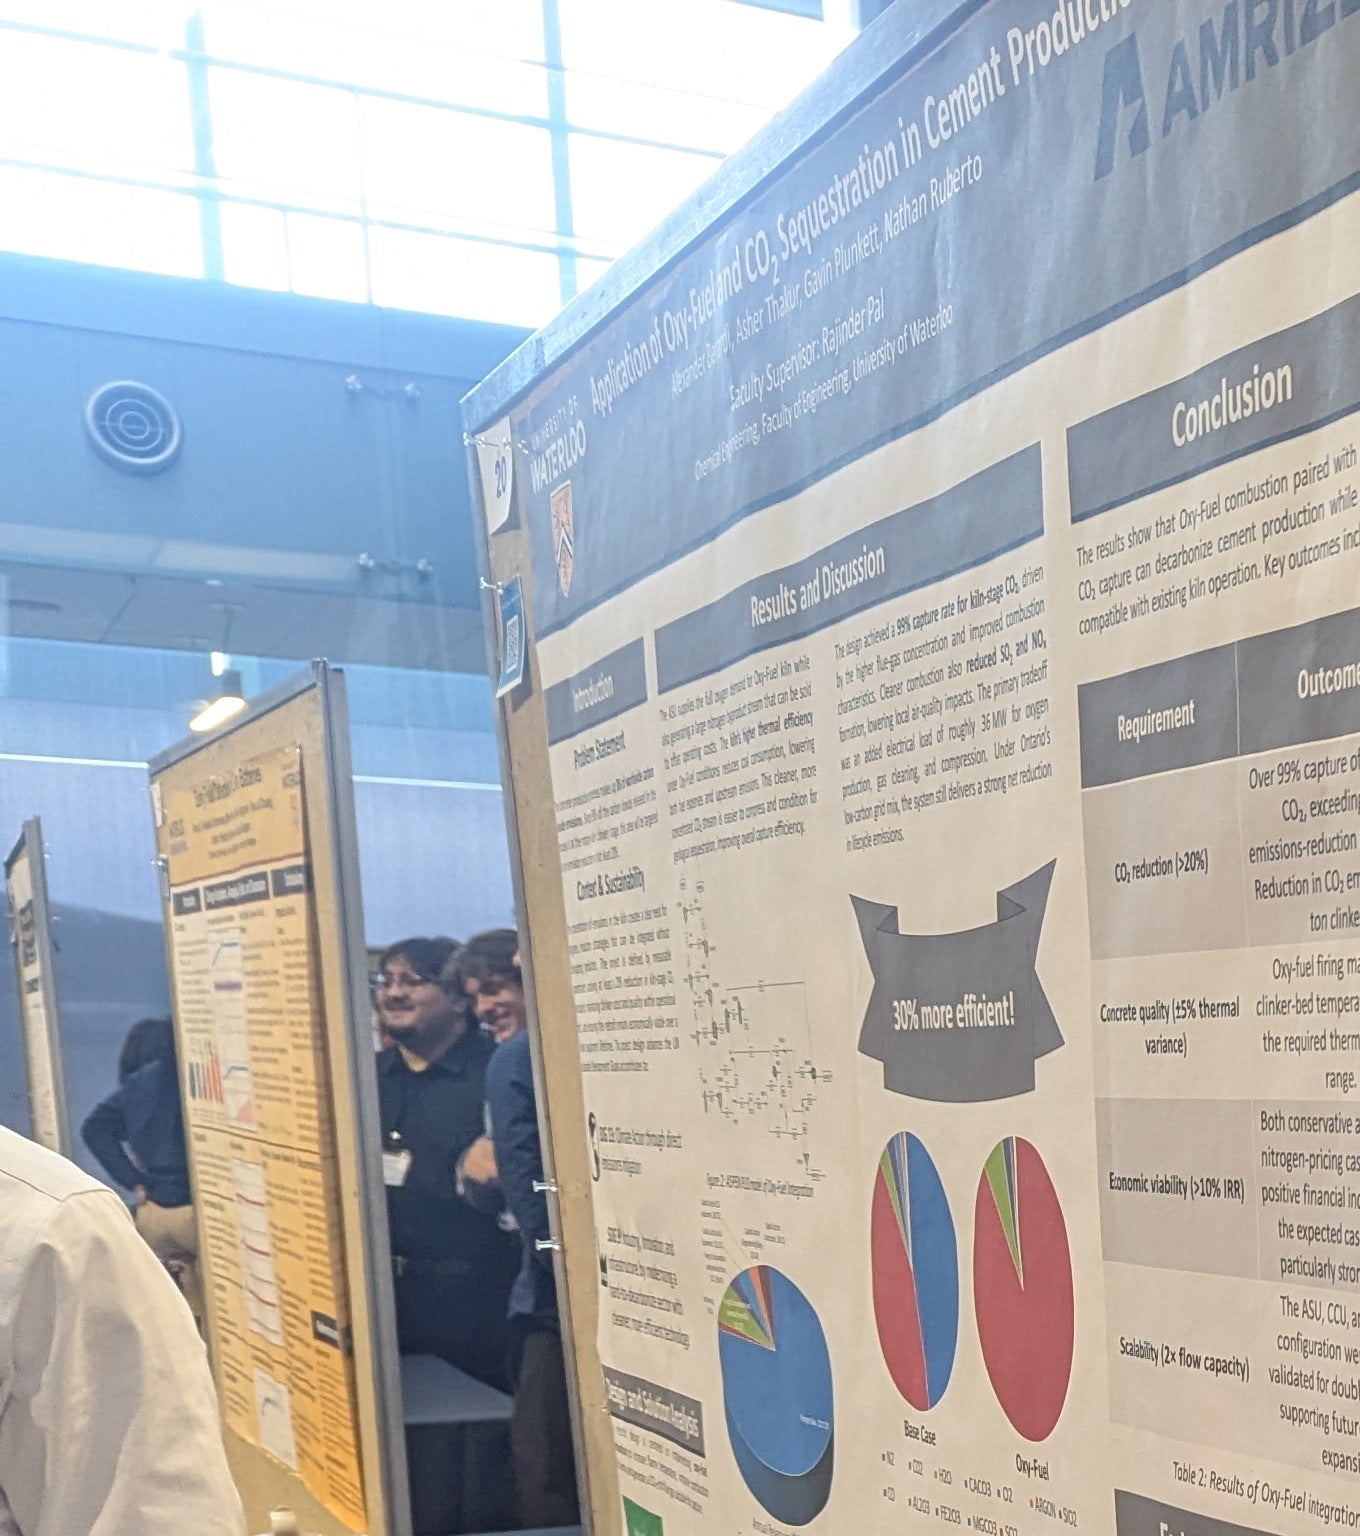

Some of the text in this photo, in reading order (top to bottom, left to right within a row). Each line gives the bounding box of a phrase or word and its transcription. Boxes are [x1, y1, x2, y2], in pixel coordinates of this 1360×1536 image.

[590, 346, 651, 419] Application
[651, 328, 664, 366] of
[663, 275, 715, 352] Oxy-Fuel
[716, 245, 742, 308] and
[776, 142, 901, 261] Sequestration
[899, 116, 921, 168] in
[923, 53, 1006, 150] Cement
[736, 310, 763, 344] Asher
[765, 283, 802, 319] Thakur,
[804, 257, 833, 299] Gavin
[834, 223, 883, 276] Plunkett,
[884, 193, 927, 239] Nathan
[929, 153, 983, 212] Ruberto
[730, 287, 884, 412] Faculty Supervisor: Rajinder Pal
[762, 400, 792, 436] Faculty
[793, 394, 801, 418] of
[802, 369, 851, 413] Engineering,
[853, 339, 896, 382] University
[898, 324, 908, 354] of
[909, 304, 953, 347] Waterloo
[1172, 364, 1293, 447] Conclusion
[494, 455, 507, 499] 20
[530, 419, 587, 494] WATERLOO
[1077, 547, 1093, 567] The
[1097, 533, 1125, 562] results
[1128, 525, 1151, 552] show
[1155, 513, 1176, 537] that
[1179, 493, 1221, 531] Oxy-Fuel
[1225, 475, 1288, 512] combustion
[1293, 458, 1329, 493] paired
[1334, 445, 1357, 474] with
[1098, 571, 1132, 597] capture
[1135, 560, 1151, 580] can
[1155, 537, 1213, 575] decarbonize
[1218, 522, 1256, 554] cement
[1262, 501, 1324, 539] production
[1329, 486, 1357, 516] while
[751, 544, 885, 628] Results and Discussion
[1079, 601, 1128, 636] compatible
[1130, 594, 1149, 622] with
[1152, 585, 1186, 611] existing
[1189, 577, 1206, 601] kiln
[1208, 562, 1261, 597] operation.
[1264, 553, 1285, 579] Key
[1289, 535, 1340, 570] outcomes
[1118, 699, 1196, 743] Requirement
[1249, 766, 1274, 789] Over
[1277, 760, 1301, 783] 99%
[1304, 752, 1347, 783] capture
[1132, 857, 1173, 880] reduction
[1176, 848, 1209, 876] (>20%)
[1249, 830, 1357, 865] emissions-reduction
[1255, 874, 1309, 900] Reduction
[1312, 872, 1322, 894] in
[1310, 911, 1327, 932] ton
[893, 991, 1014, 1030] 30% more efficient!
[1100, 1002, 1137, 1023] Concrete
[1139, 1000, 1170, 1024] quality
[1199, 996, 1240, 1018] thermal
[1145, 1032, 1187, 1058] variance)
[1015, 1454, 1049, 1480] Oxy-Fuel
[1173, 1460, 1196, 1485] Table
[1199, 1468, 1207, 1488] 2:
[1209, 1471, 1244, 1497] Results
[1247, 1479, 1258, 1504] of
[1261, 1483, 1305, 1512] Oxy-Fuel
